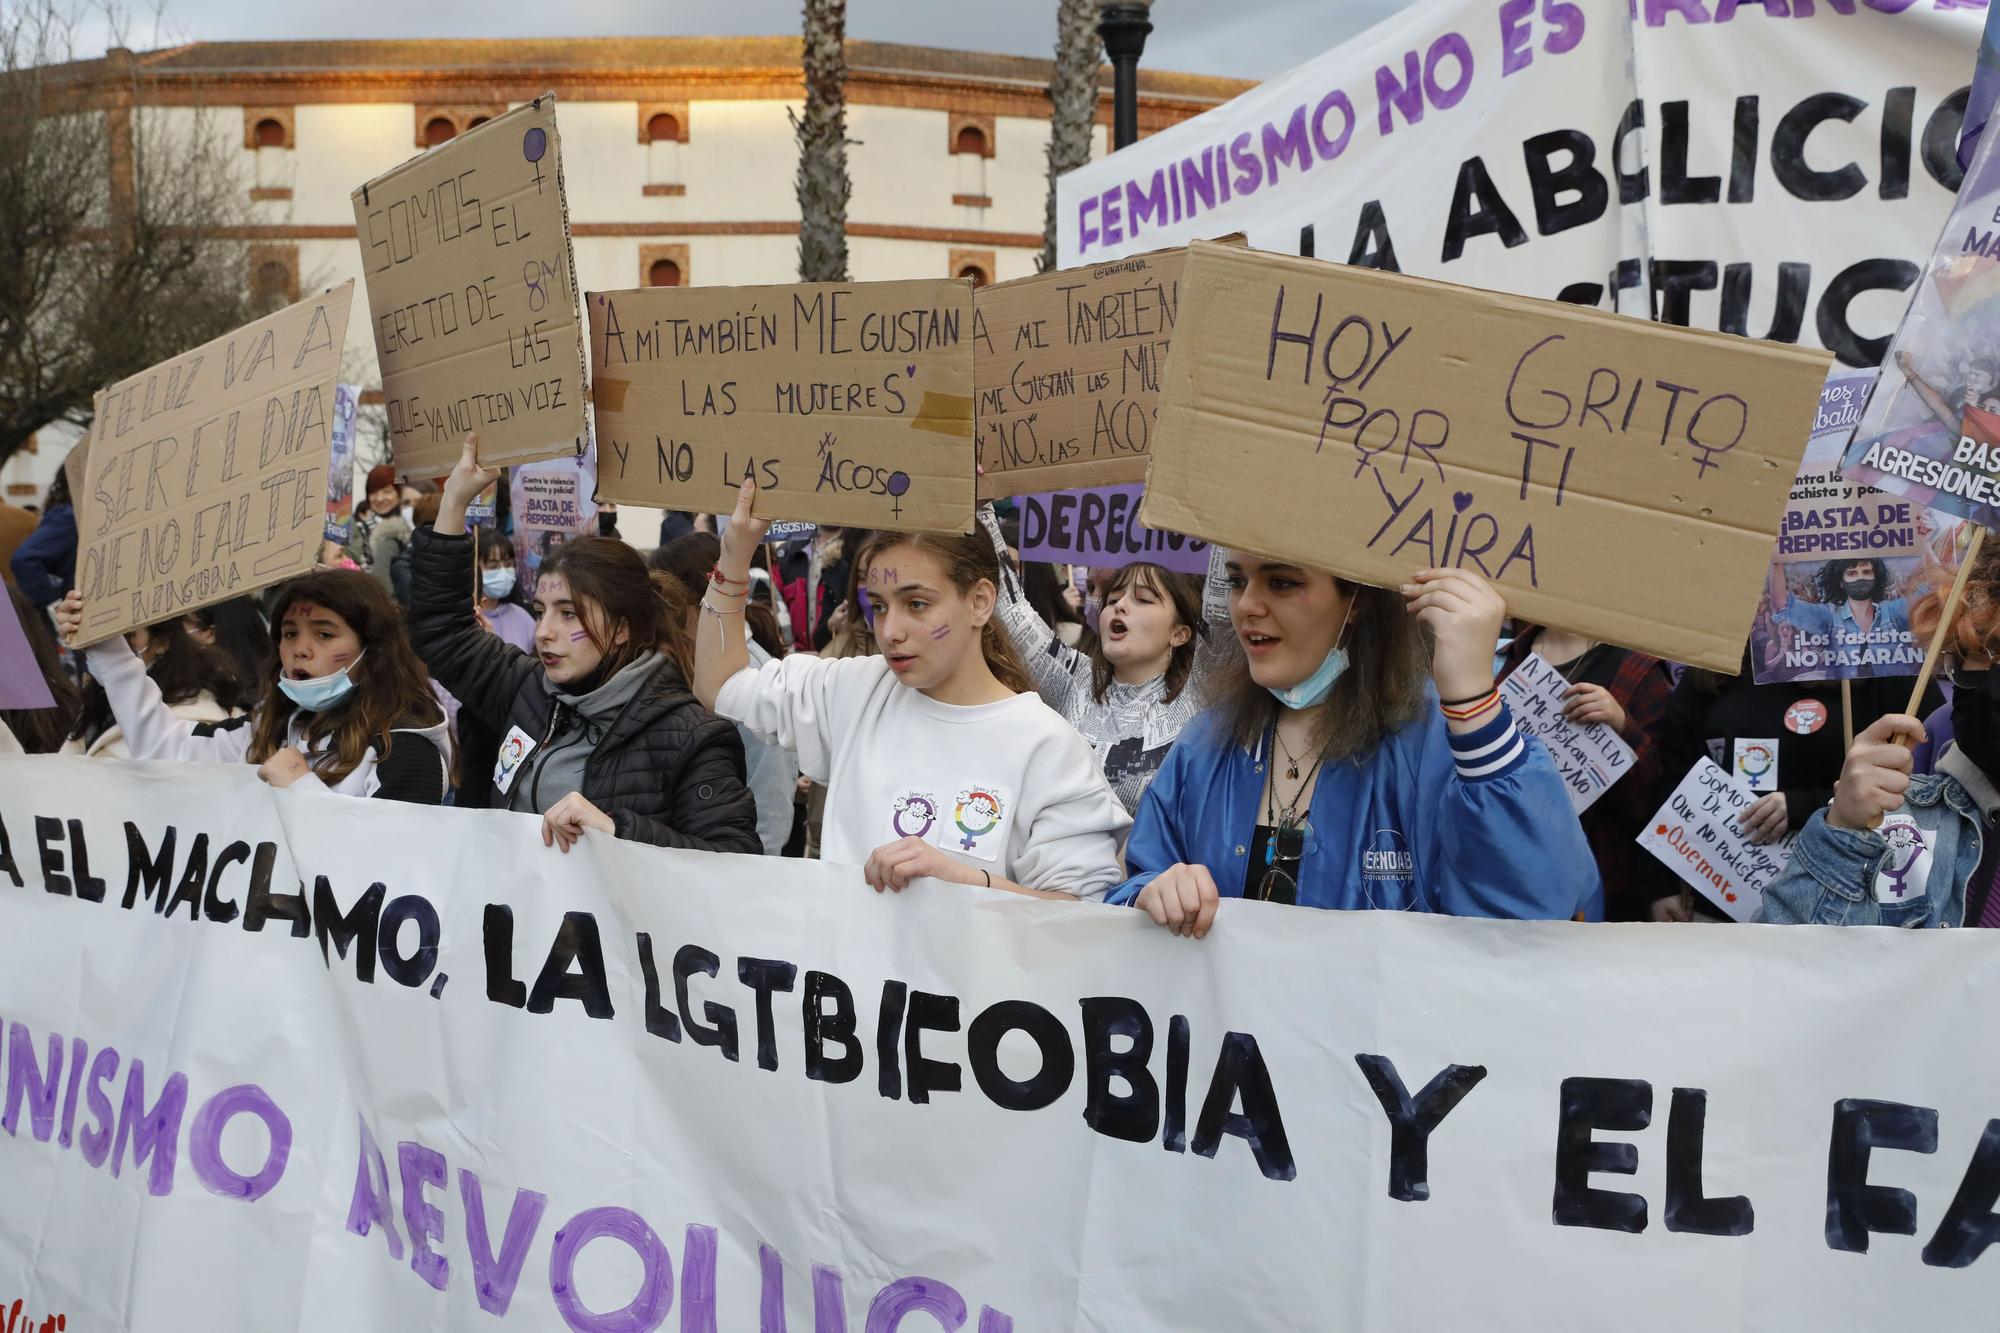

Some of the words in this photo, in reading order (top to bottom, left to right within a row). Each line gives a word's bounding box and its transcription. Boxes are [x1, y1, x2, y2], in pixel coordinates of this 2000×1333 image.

[1079, 89, 1356, 255] FEMINISMO
[1375, 32, 1475, 137] NO
[1499, 0, 1586, 79] ES
[367, 169, 482, 272] SOMOS
[491, 204, 532, 247] EL
[523, 252, 566, 313] 8M
[380, 293, 459, 354] GRITO
[465, 276, 504, 326] DE
[604, 298, 628, 368] A
[793, 291, 853, 355] ME
[860, 307, 961, 355] GUSTAN
[973, 308, 994, 355] A
[1015, 319, 1050, 351] MI
[1056, 277, 1178, 345] TAMBIÉN
[508, 320, 551, 368] LAS
[100, 356, 204, 441] FELIZ
[224, 330, 276, 390] VA
[292, 305, 332, 369] A
[682, 379, 738, 416] LAS
[776, 373, 906, 416] MUJERES
[981, 387, 1008, 415] ME
[1011, 360, 1075, 404] GUSTAN
[1087, 372, 1110, 393] LAS
[1267, 284, 1412, 395] HOY
[1505, 335, 1749, 465] GRITO
[388, 396, 424, 438] QUE
[423, 407, 449, 443] YA
[447, 399, 475, 434] NO
[472, 390, 515, 427] TIEN
[518, 378, 567, 411] VOZ
[977, 435, 985, 465] Y
[999, 419, 1038, 471] NO
[1049, 438, 1080, 463] LAS
[1093, 399, 1158, 455] ACO
[95, 437, 179, 536] SER
[185, 411, 242, 498] EL
[260, 386, 327, 469] DIA
[612, 440, 630, 480] Y
[656, 435, 695, 484] NO
[724, 452, 780, 491] LAS
[1316, 397, 1449, 483] POR
[1511, 431, 1575, 506] TI
[1830, 471, 1843, 482] la
[526, 511, 576, 527] REPRESIÓN!
[527, 498, 558, 513] ¡BASTA
[561, 501, 574, 513] DE
[1781, 506, 1871, 536] ¡BASTA
[1878, 503, 1910, 525] DE
[1843, 487, 1852, 499] y
[83, 531, 136, 602] QUE
[138, 519, 181, 587] NO
[192, 468, 320, 568] FALTE
[772, 521, 816, 534] FASCISTAS
[1778, 527, 1914, 554] REPRESIÓN!
[1522, 657, 1540, 678] A
[1785, 651, 1822, 668] NO
[1794, 630, 1830, 649] ¡Los
[1523, 694, 1549, 719] ME
[1565, 769, 1591, 795] NO
[1667, 825, 1733, 895] Quemar
[1695, 823, 1717, 844] NO
[35, 815, 107, 904] EL
[483, 903, 615, 1020] LA
[636, 932, 1298, 1182] LGTBIFOBIA
[1354, 1052, 1488, 1202] Y
[1552, 1076, 1755, 1237] EL
[0, 1016, 293, 1202] NISMO
